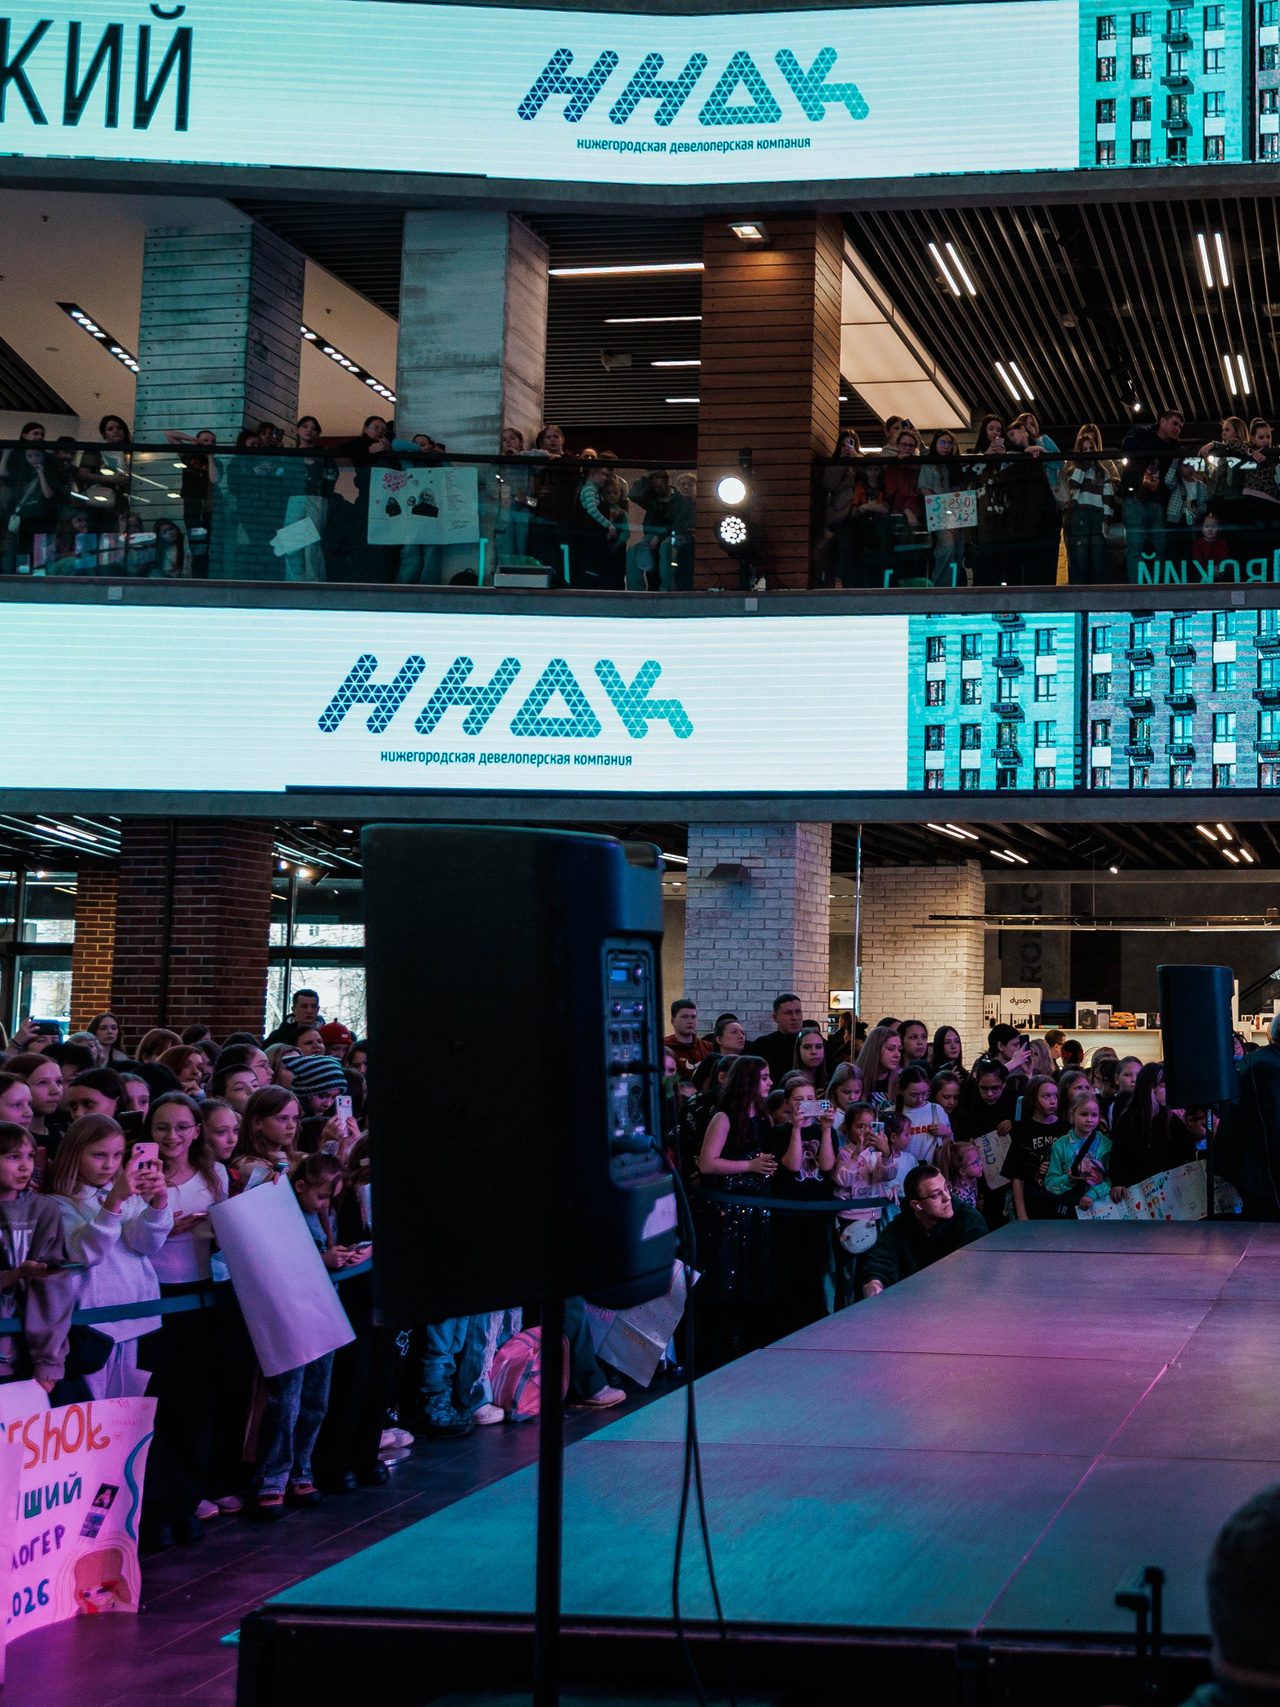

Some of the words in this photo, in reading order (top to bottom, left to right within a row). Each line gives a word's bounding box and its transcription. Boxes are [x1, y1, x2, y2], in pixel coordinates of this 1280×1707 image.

[0, 4, 193, 132] КИЙ
[577, 138, 667, 153] нижегородская
[669, 140, 753, 154] девелоперская
[756, 138, 811, 150] компания
[380, 750, 475, 767] нижегородская
[478, 752, 570, 767] девелоперская
[574, 753, 632, 766] компания
[1010, 996, 1031, 1005] dyson
[16, 1471, 82, 1521] ШИЙ
[7, 1578, 50, 1624] 026
